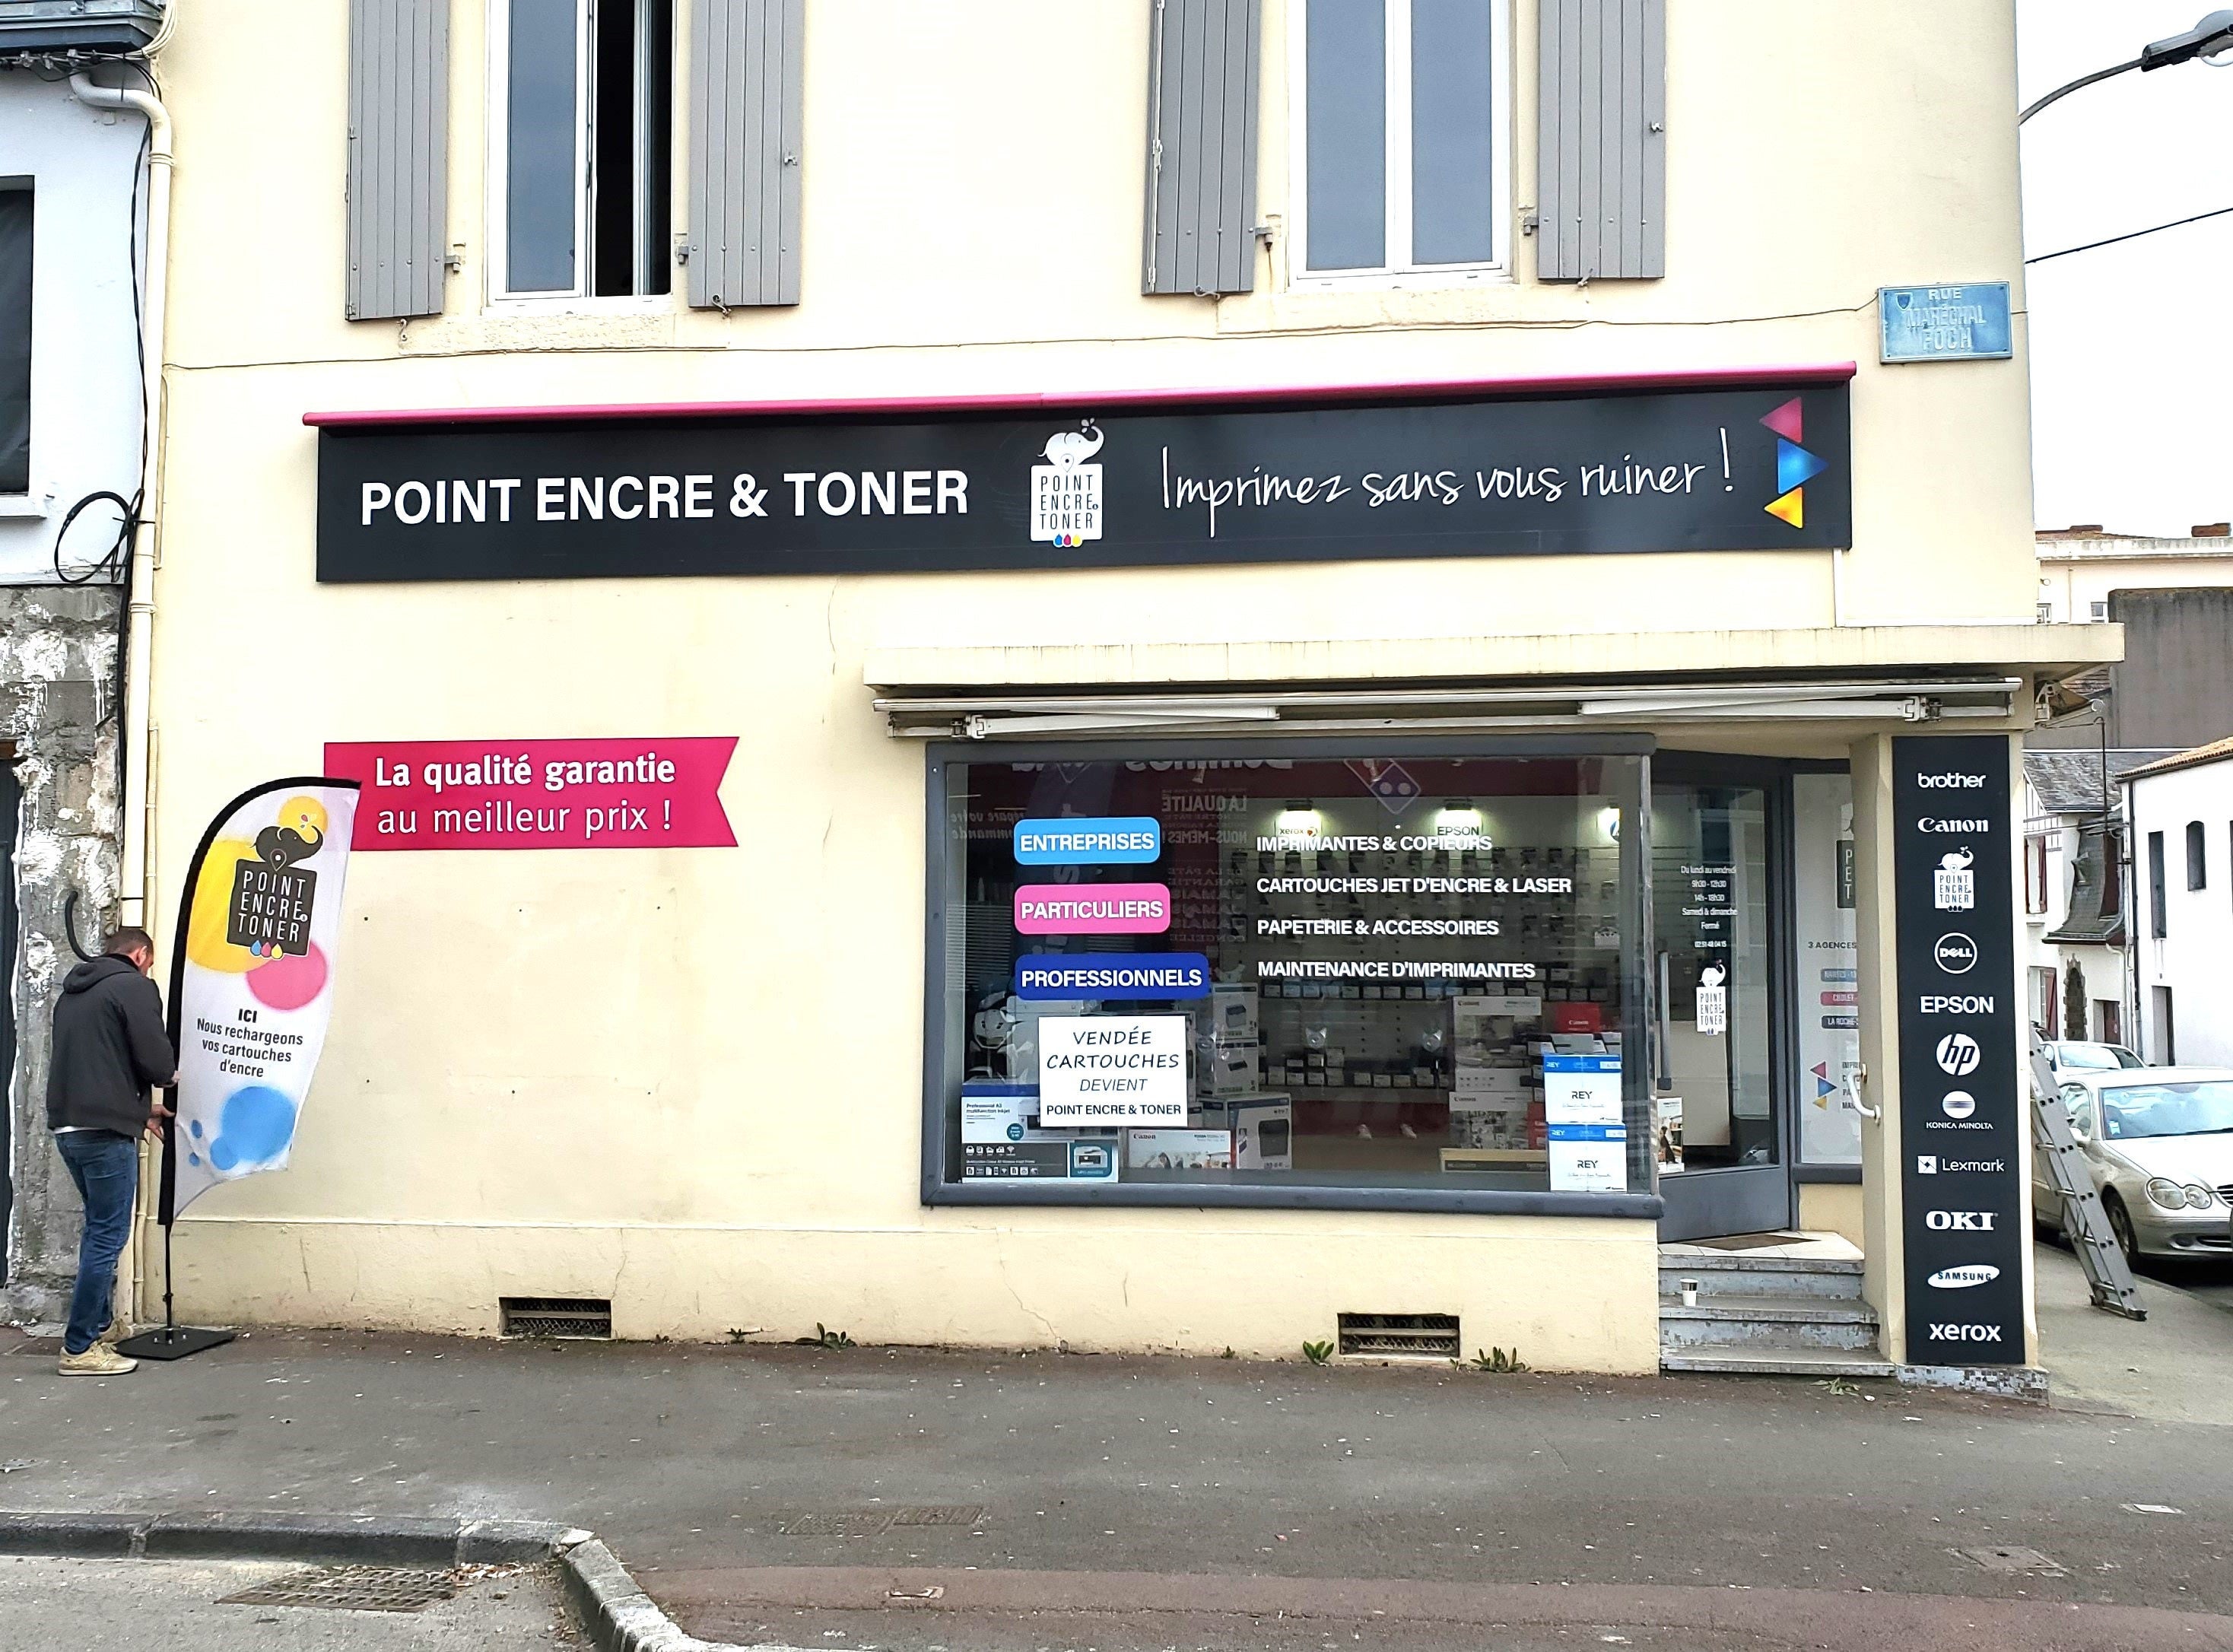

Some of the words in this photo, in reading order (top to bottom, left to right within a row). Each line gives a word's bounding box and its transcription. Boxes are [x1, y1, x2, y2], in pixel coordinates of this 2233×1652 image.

[1928, 288, 1962, 301] RUE
[1922, 328, 1973, 351] FOCH
[1040, 475, 1093, 492] POINT
[1162, 446, 1352, 538] Imprimez
[1361, 470, 1465, 508] sans
[1475, 465, 1568, 502] vous
[1578, 453, 1706, 497] ruiner
[1720, 427, 1735, 493] !
[361, 478, 521, 526] POINT
[535, 475, 715, 522] ENCRE
[729, 473, 768, 518] &
[783, 469, 969, 517] TONER
[1040, 494, 1093, 510] ENCRE
[1040, 513, 1093, 529] TONER
[376, 758, 411, 787] La
[423, 753, 532, 793] qualité
[545, 751, 676, 792] garantie
[1917, 773, 1986, 788] brother
[377, 808, 418, 834] au
[434, 800, 571, 833] meilleur
[585, 799, 650, 840] prix
[662, 799, 672, 830] !
[1917, 817, 1989, 833] Canon
[1437, 826, 1479, 836] EPSON
[1021, 833, 1155, 852] ENTREPRISES
[1256, 836, 1380, 851] IMPRIMANTES
[1383, 836, 1397, 851] &
[1399, 836, 1492, 851] COPIEURS
[1681, 866, 1689, 874] Du
[243, 870, 306, 898] POINT
[1256, 878, 1379, 893] CARTOUCHES
[1380, 878, 1411, 893] JET
[1413, 878, 1491, 893] D'ENCRE
[1494, 878, 1509, 893] &
[1513, 878, 1572, 893] LASER
[1939, 875, 1968, 883] POINT
[1939, 885, 1968, 893] ENCRE
[240, 891, 303, 921] ENCRE
[1939, 894, 1969, 903] TONER
[1021, 901, 1163, 920] PARTICULIERS
[238, 913, 300, 943] TONER
[1257, 920, 1352, 936] PAPETERIE
[1355, 920, 1370, 936] &
[1371, 920, 1500, 936] ACCESSOIRES
[1940, 947, 1973, 958] DELL
[1257, 961, 1389, 977] MAINTENANCE
[1392, 961, 1536, 979] D'IMPRIMANTES
[1021, 970, 1202, 987] PROFESSIONNELS
[1700, 993, 1722, 1002] POINT
[1920, 996, 1994, 1014] EPSON
[238, 1009, 258, 1023] ICI
[1700, 1004, 1723, 1014] ENCRE
[1700, 1015, 1723, 1025] TONER
[197, 1018, 222, 1035] Nous
[224, 1026, 303, 1046] rechargeons
[1072, 1025, 1152, 1045] VENDÉE
[202, 1039, 219, 1053] vos
[222, 1043, 291, 1062] cartouches
[1941, 1033, 1977, 1075] hp
[220, 1059, 264, 1077] d'encre
[1047, 1053, 1180, 1069] CARTOUCHES
[1079, 1079, 1148, 1091] DEVIENT
[1571, 1091, 1593, 1100] REY
[1047, 1105, 1083, 1116] POINT
[1085, 1105, 1126, 1115] ENCRE
[1128, 1105, 1138, 1114] &
[1139, 1104, 1181, 1115] TONER
[1958, 1122, 1993, 1130] MINOLTA
[1577, 1160, 1599, 1169] REY
[1942, 1158, 2005, 1172] Lexmark
[1926, 1210, 1994, 1231] OKI
[1938, 1270, 1992, 1282] SAMSUNG
[1929, 1323, 2002, 1342] xerox
